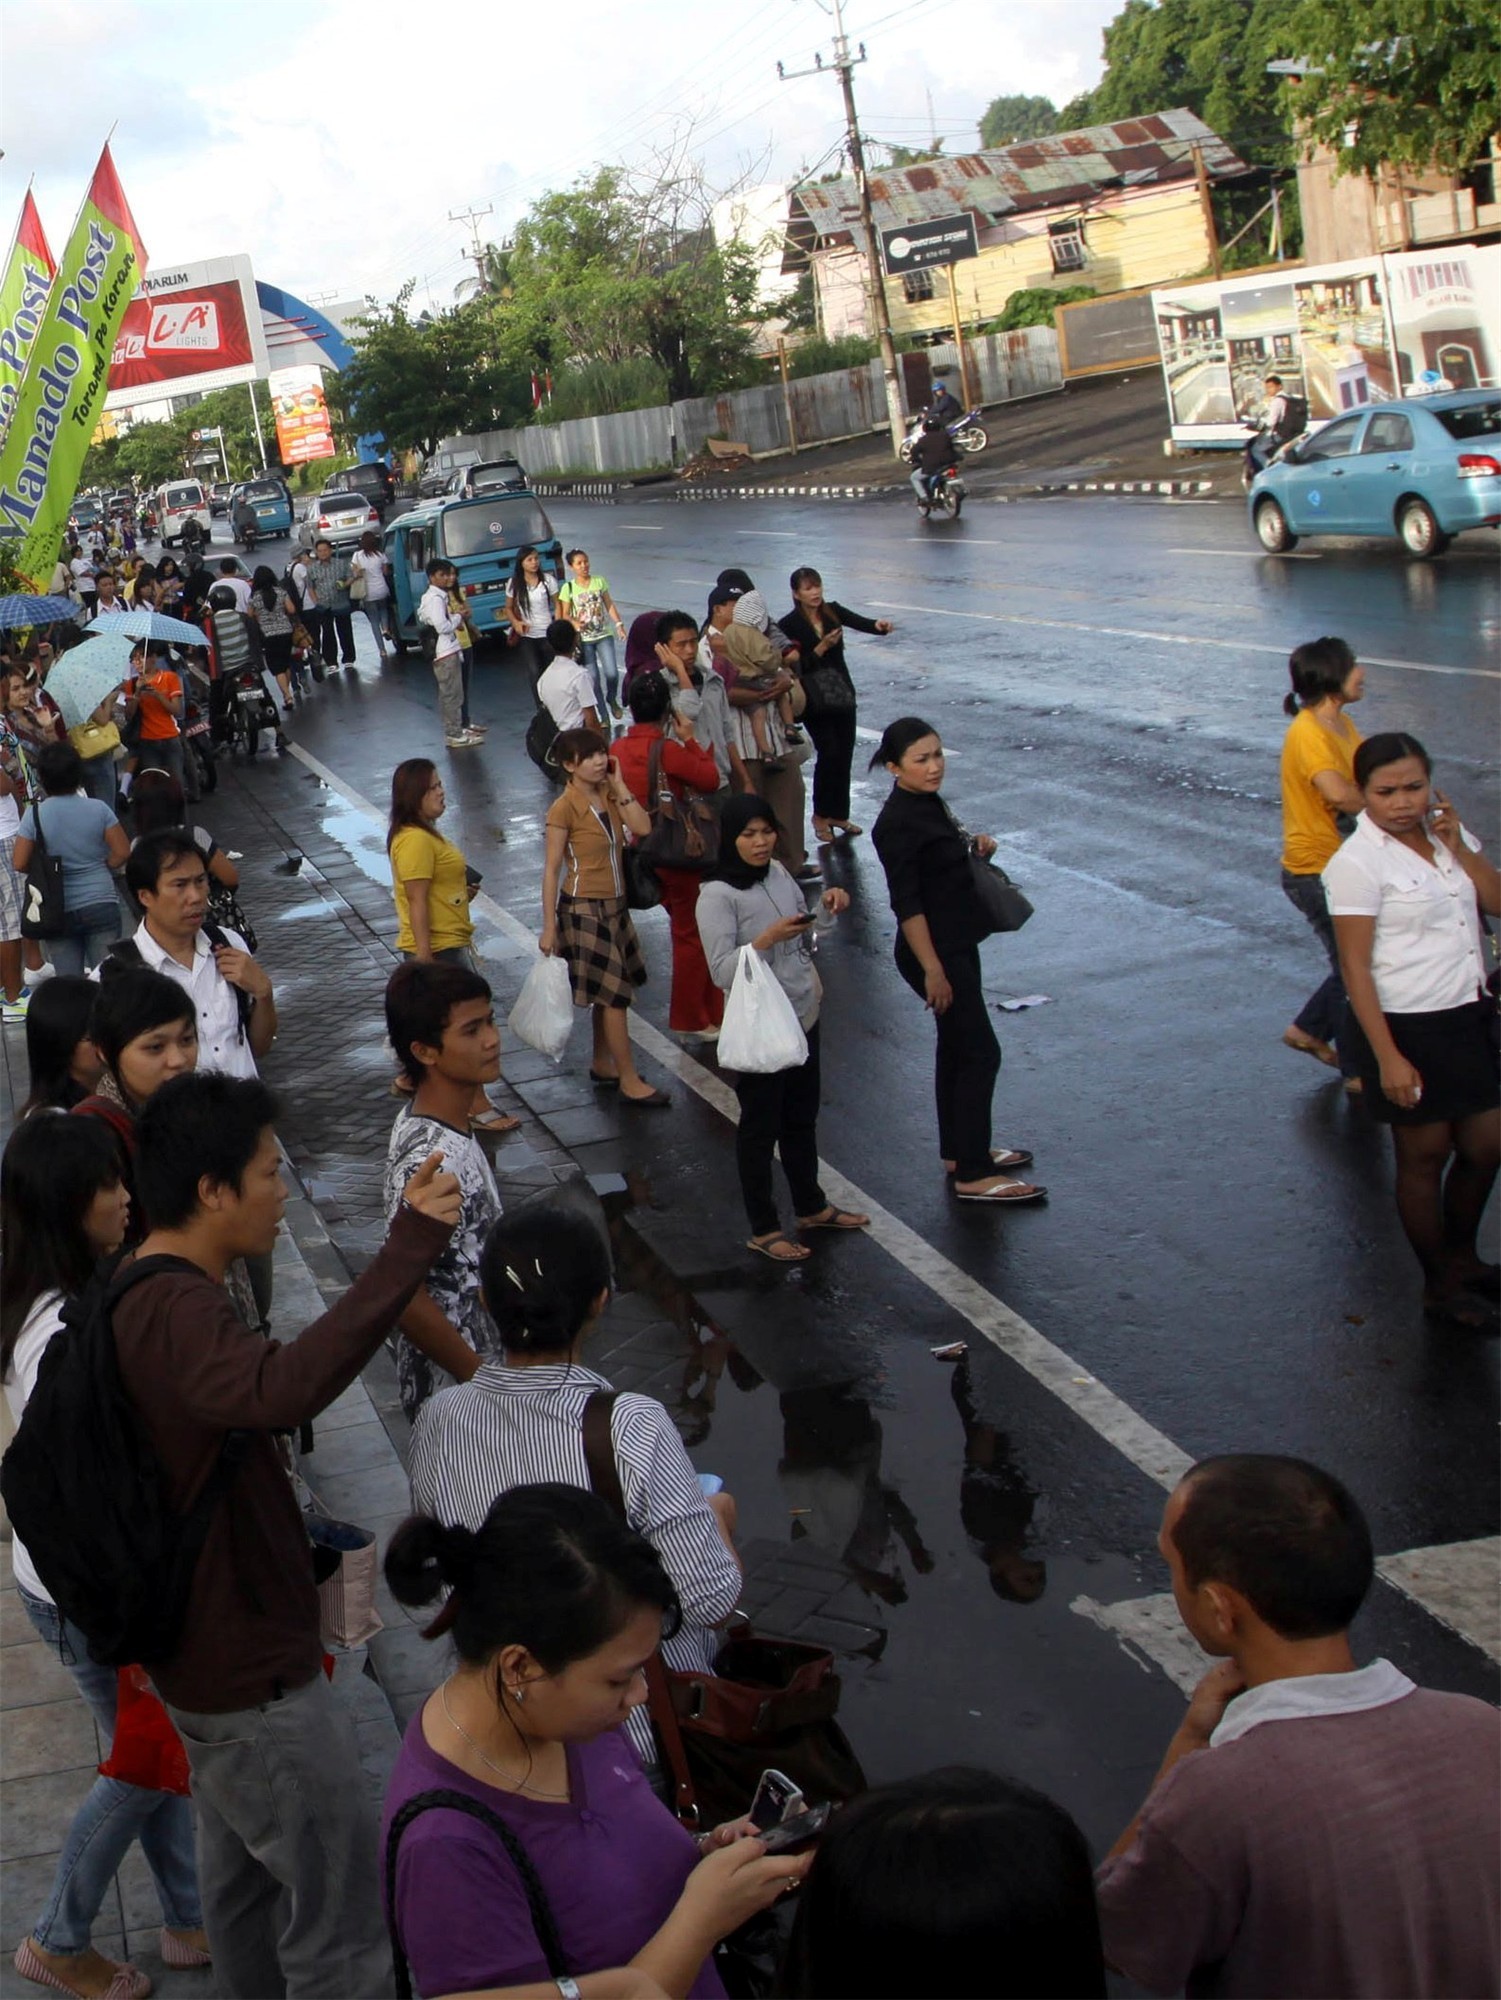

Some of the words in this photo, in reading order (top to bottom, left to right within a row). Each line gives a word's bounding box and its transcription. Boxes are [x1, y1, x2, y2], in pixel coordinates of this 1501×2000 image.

[0, 263, 51, 372] Post
[56, 220, 115, 340] Post
[94, 322, 108, 350] Pe
[102, 253, 135, 320] Koran
[175, 336, 208, 347] LIGHTS
